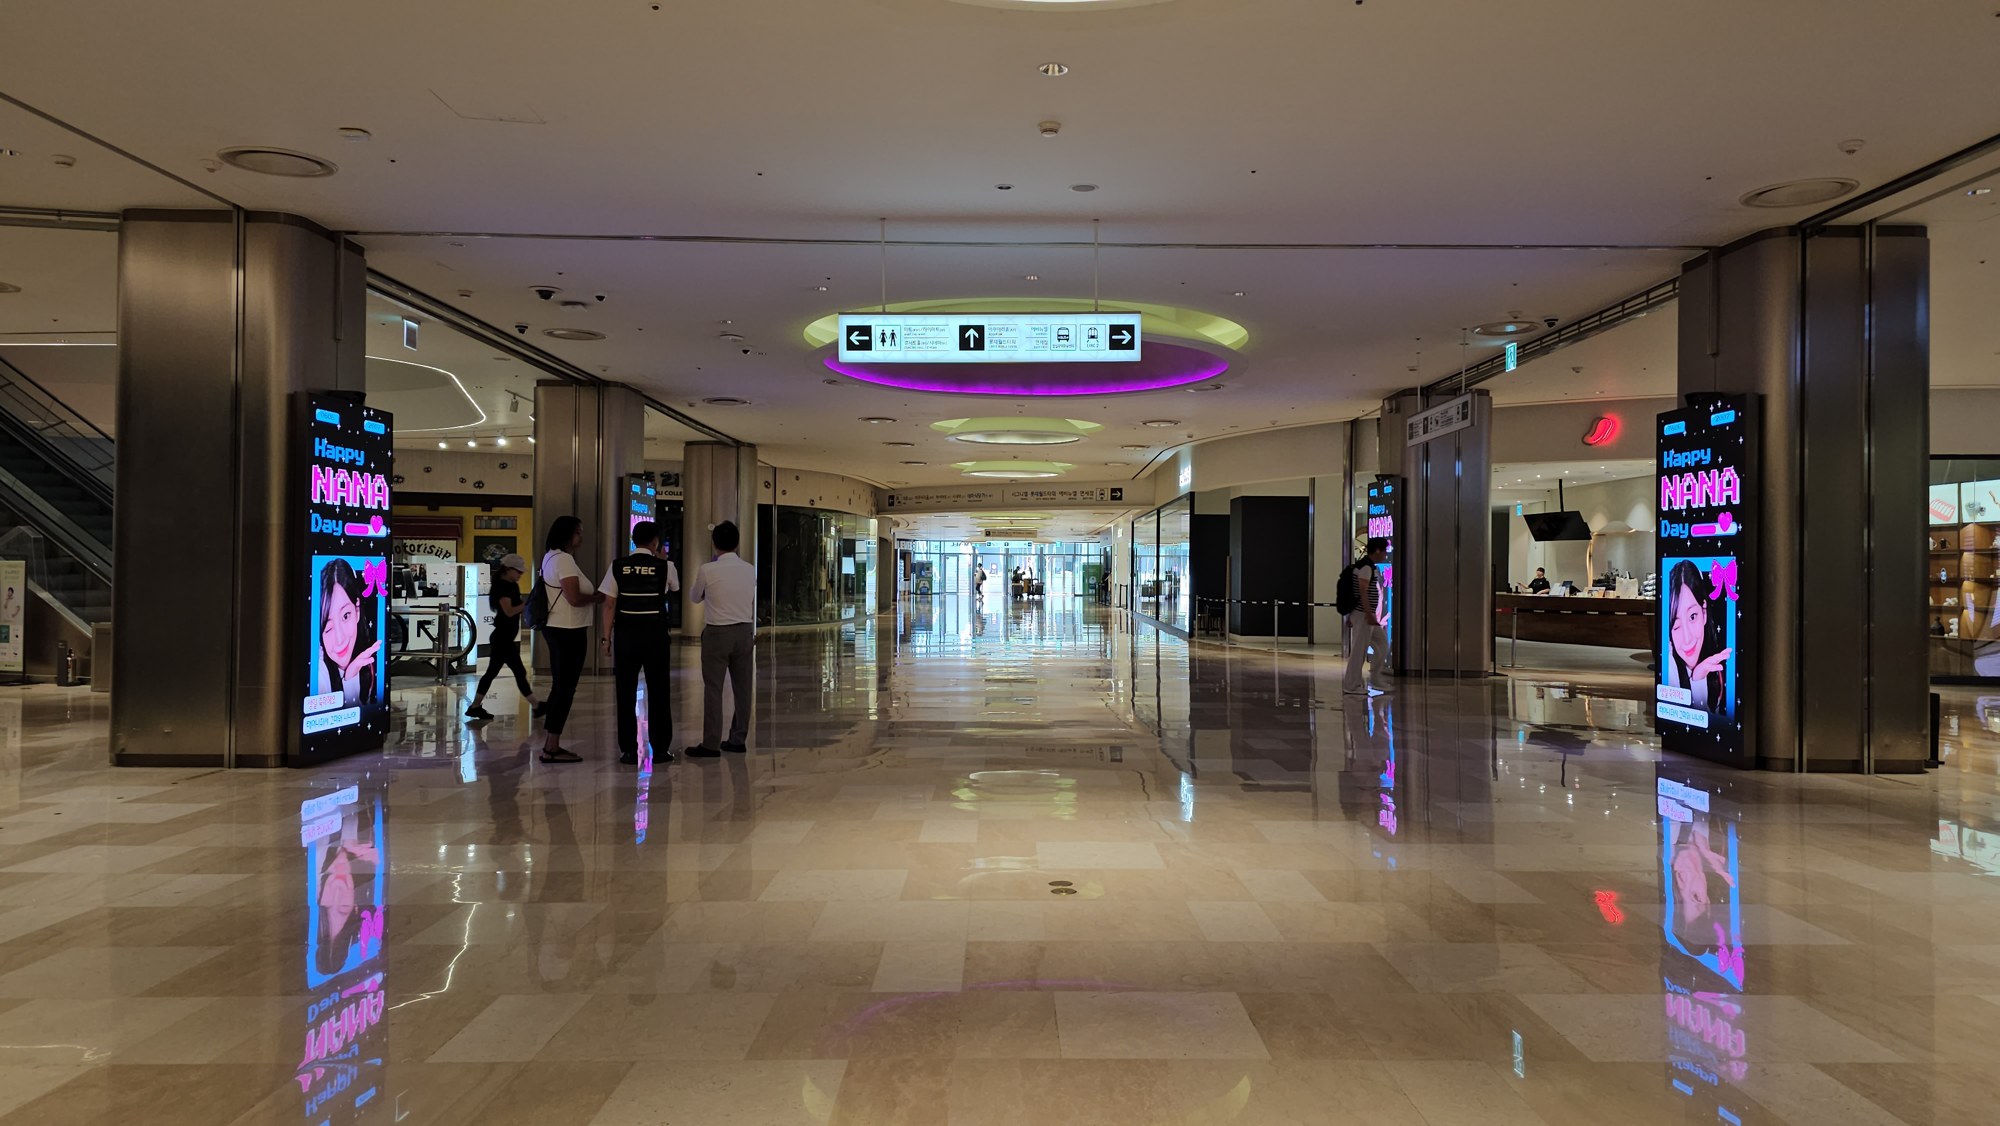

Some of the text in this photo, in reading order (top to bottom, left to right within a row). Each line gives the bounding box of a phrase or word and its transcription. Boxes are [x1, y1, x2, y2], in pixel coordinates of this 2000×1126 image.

[314, 437, 365, 466] Happy
[1663, 448, 1711, 469] Happy
[311, 464, 389, 510] NANA
[1661, 465, 1741, 511] NANA
[311, 513, 344, 536] Day
[1661, 519, 1689, 539] Day
